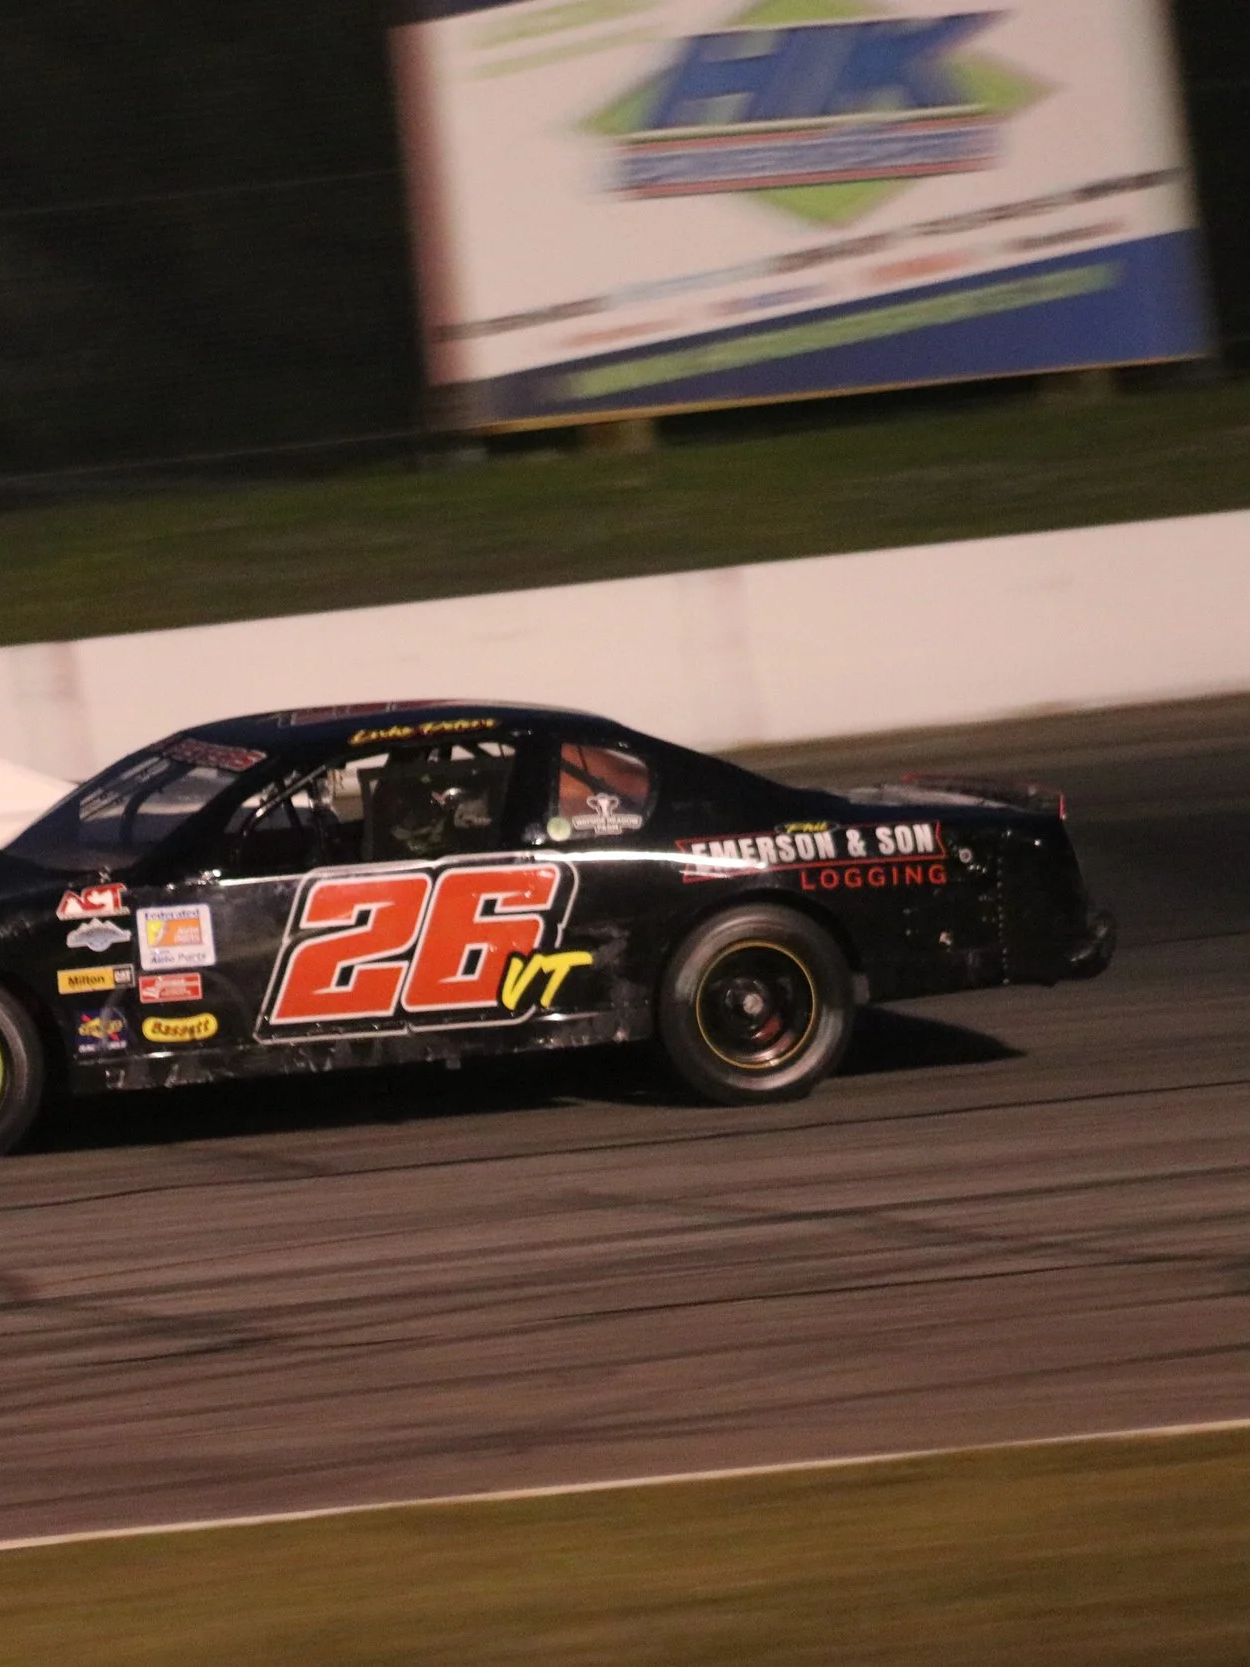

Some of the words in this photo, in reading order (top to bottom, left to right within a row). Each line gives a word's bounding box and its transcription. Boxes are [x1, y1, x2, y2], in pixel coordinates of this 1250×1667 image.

[690, 831, 835, 872] EMERSON
[846, 829, 867, 857] &
[875, 824, 934, 854] SON
[801, 864, 947, 890] LOGGING
[59, 884, 127, 915] ACT
[269, 864, 560, 1024] 26
[68, 974, 105, 987] Milton
[502, 951, 593, 1010] VT
